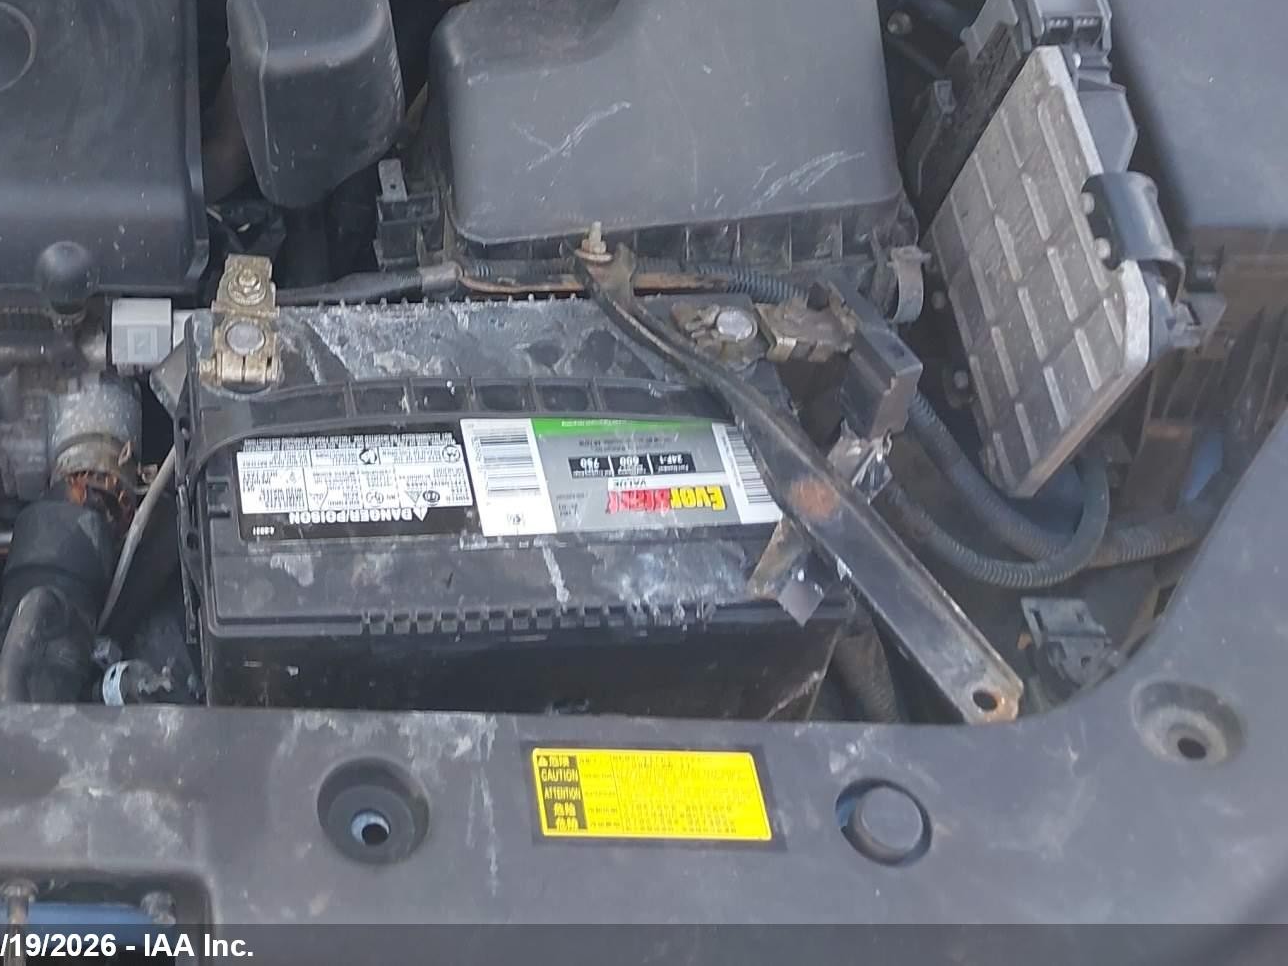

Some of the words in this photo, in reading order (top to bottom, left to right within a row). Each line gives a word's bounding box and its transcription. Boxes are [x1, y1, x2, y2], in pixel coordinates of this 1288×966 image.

[289, 507, 413, 525] DANGER/POISON
[541, 768, 579, 782] CAUTION
[544, 786, 582, 800] ATTENTION
